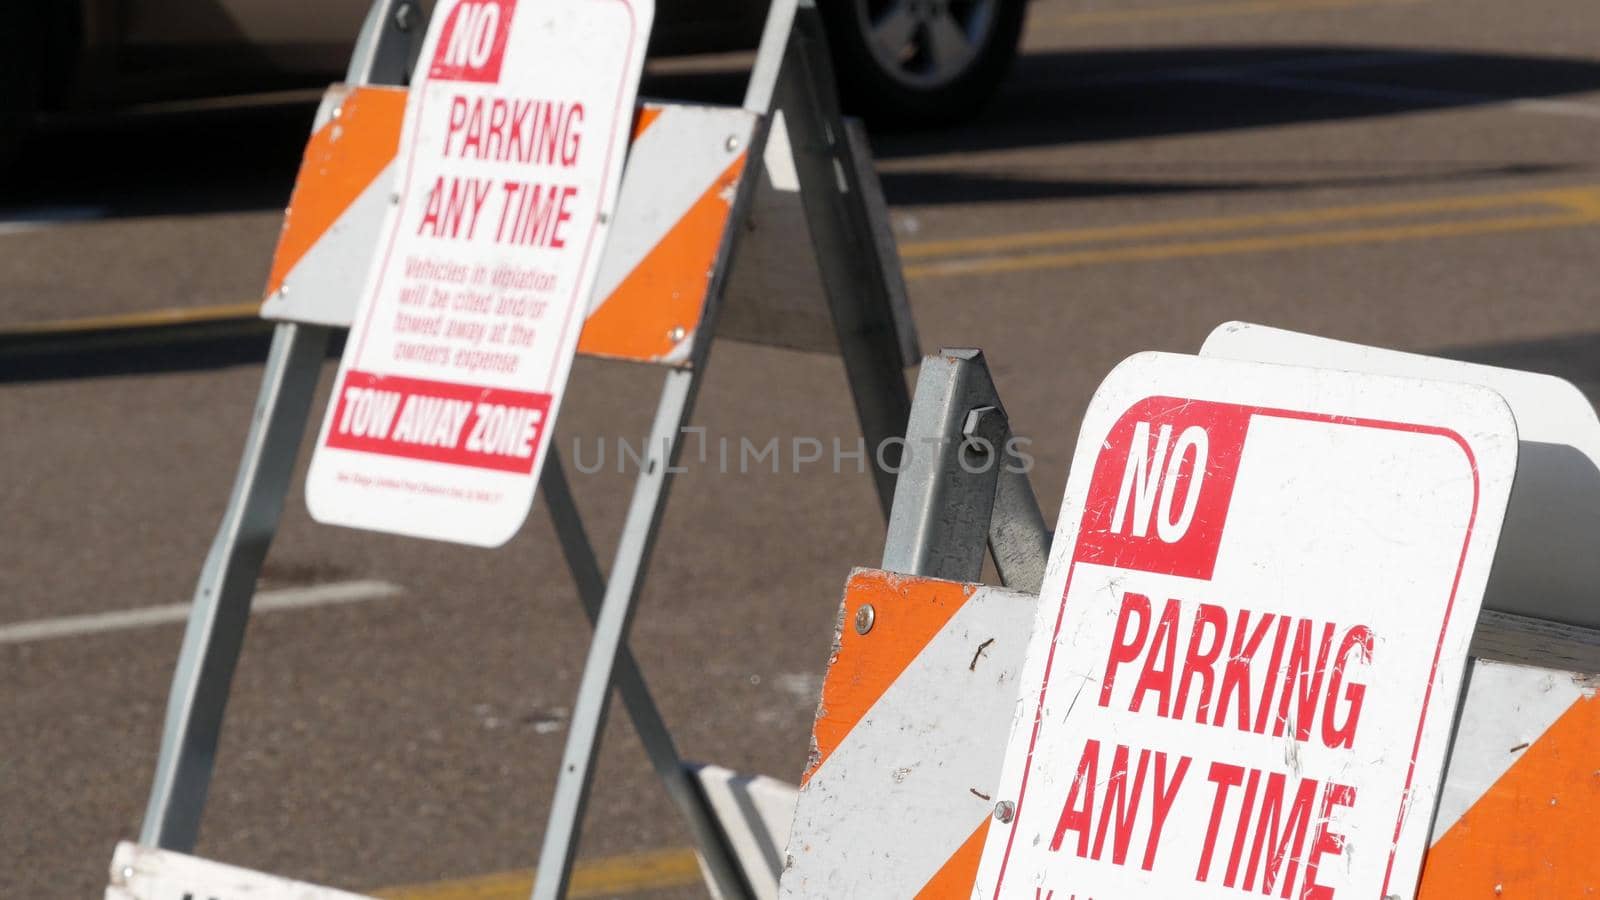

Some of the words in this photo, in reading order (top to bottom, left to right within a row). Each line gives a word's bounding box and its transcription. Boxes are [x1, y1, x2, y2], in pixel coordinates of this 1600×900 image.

[444, 2, 500, 70] NO
[443, 96, 584, 167] PARKING
[417, 176, 492, 242] ANY
[496, 182, 578, 249] TIME
[394, 311, 442, 336] towed
[446, 319, 485, 345] away
[488, 323, 507, 344] at
[509, 323, 536, 347] the
[398, 285, 428, 305] will
[429, 288, 449, 309] be
[452, 292, 493, 315] cited
[455, 349, 520, 374] expense
[339, 386, 402, 439] TOW
[391, 394, 474, 449] AWAY
[465, 403, 542, 458] ZONE
[1110, 421, 1209, 544] NO
[1098, 591, 1375, 751] PARKING
[1048, 738, 1192, 871] ANY
[1195, 761, 1358, 900] TIME
